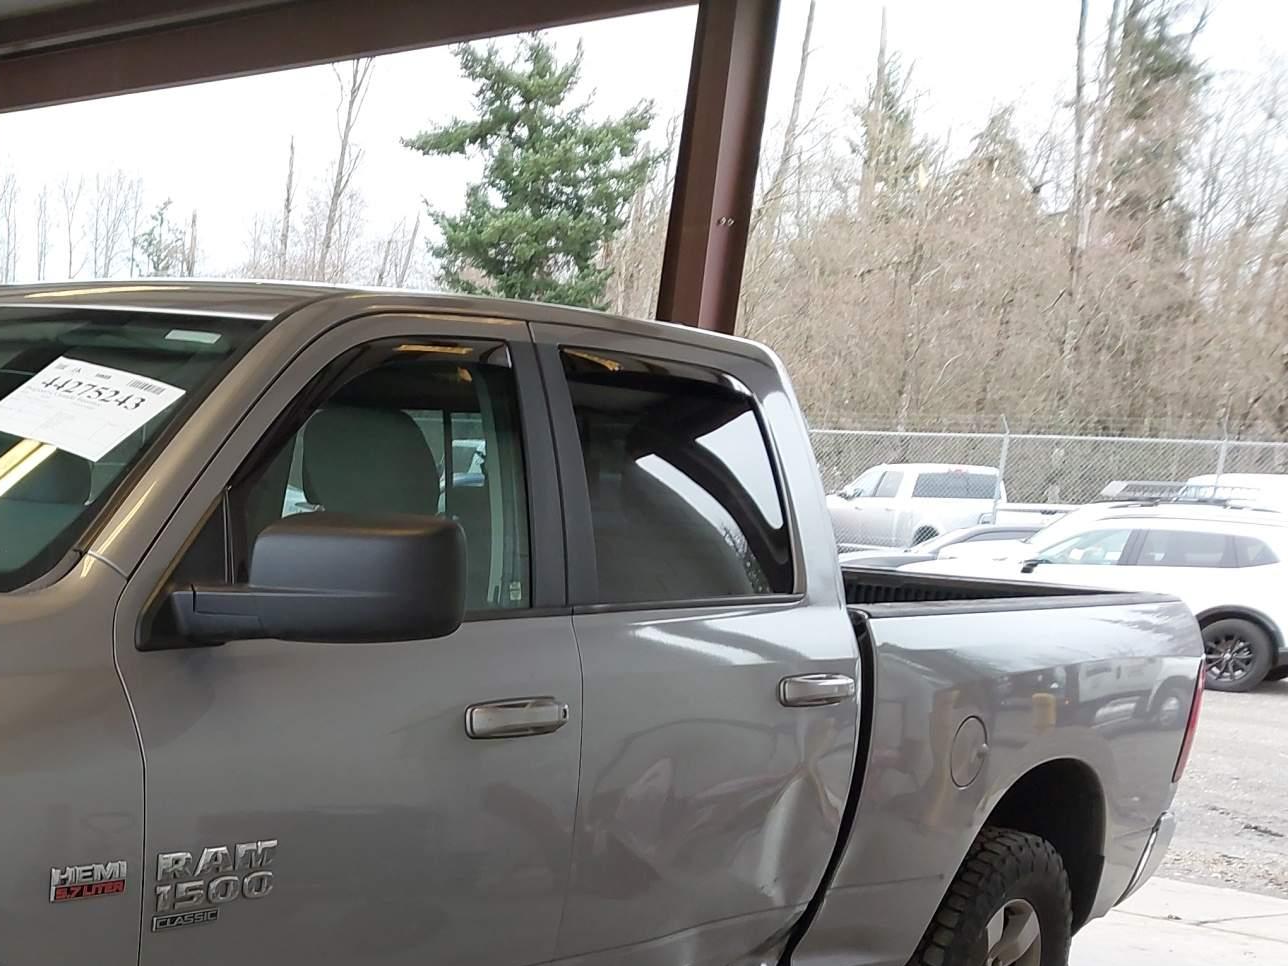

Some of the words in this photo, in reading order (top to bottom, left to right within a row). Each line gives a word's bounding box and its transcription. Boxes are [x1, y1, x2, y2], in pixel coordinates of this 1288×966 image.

[42, 375, 146, 411] 44275243
[51, 860, 127, 887] HEMI
[157, 839, 278, 882] RAM
[55, 887, 82, 900] 5.7
[85, 880, 125, 896] LITER
[155, 871, 273, 913] 1500
[157, 910, 218, 930] CLASSIC
